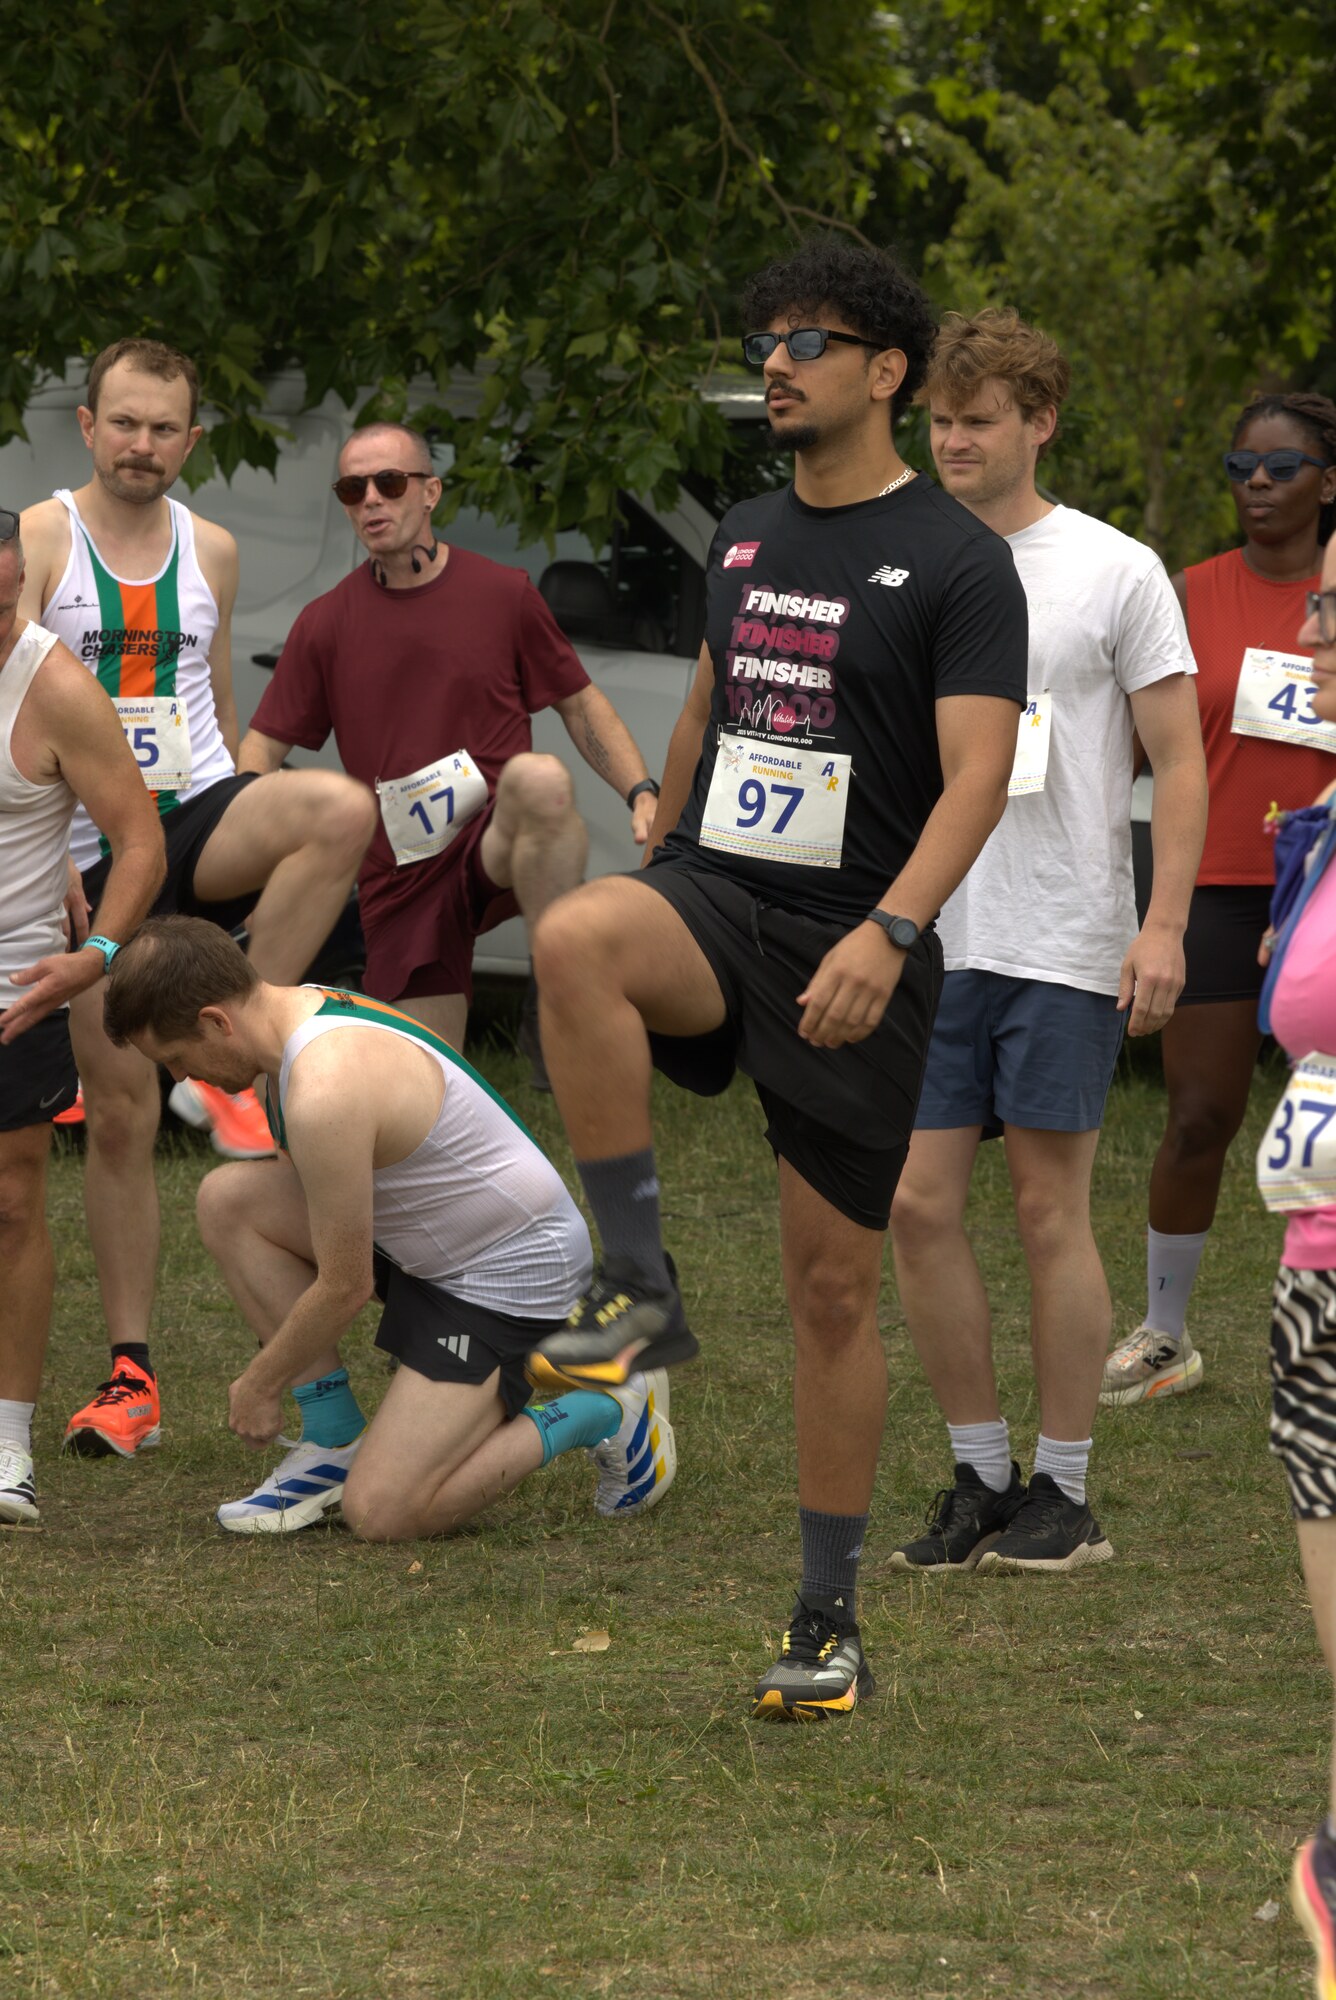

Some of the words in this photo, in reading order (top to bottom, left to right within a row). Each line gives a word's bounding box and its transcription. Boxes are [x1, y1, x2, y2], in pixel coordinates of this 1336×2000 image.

[745, 590, 845, 624] FINISHER
[82, 629, 198, 648] MORNINGTON
[737, 622, 836, 657] FINISHER
[81, 643, 160, 658] CHASERS
[731, 655, 833, 690] FINISHER
[1281, 662, 1312, 673] AFFORD
[1027, 703, 1037, 715] A
[773, 712, 796, 728] Vitality
[1032, 715, 1041, 726] R
[123, 727, 160, 768] 5
[767, 734, 793, 743] LONDON
[792, 737, 813, 745] 10,000
[748, 752, 802, 771] AFFORDABLE
[821, 762, 835, 776] A
[400, 770, 442, 793] AFFORDABLE
[752, 765, 794, 781] RUNNING
[827, 777, 839, 791] R
[408, 786, 454, 835] 17
[736, 778, 805, 835] 97
[1268, 1098, 1336, 1170] 37
